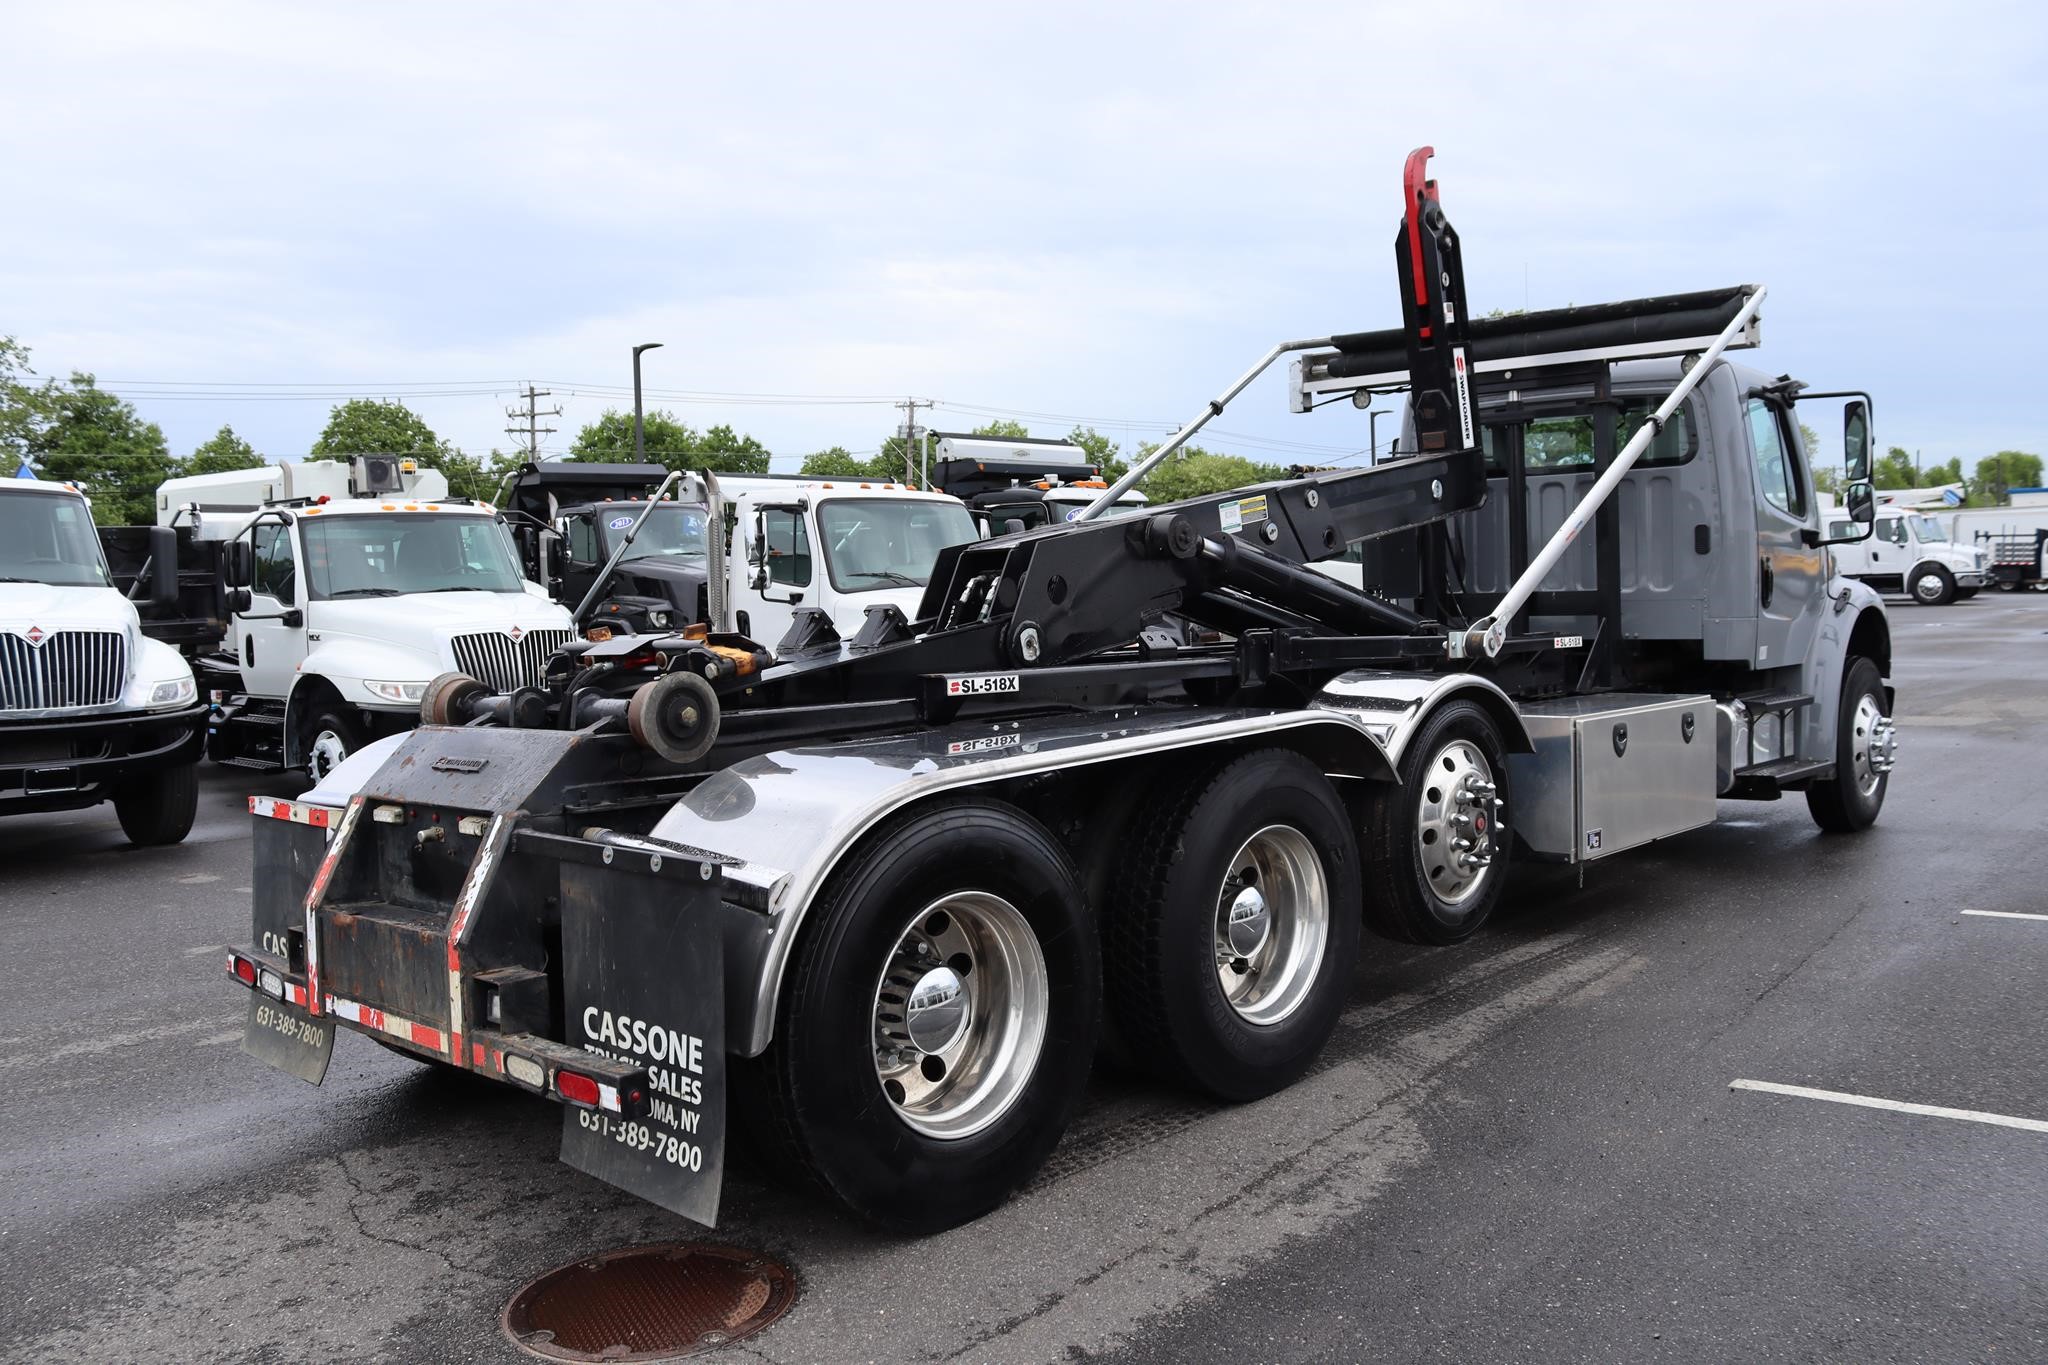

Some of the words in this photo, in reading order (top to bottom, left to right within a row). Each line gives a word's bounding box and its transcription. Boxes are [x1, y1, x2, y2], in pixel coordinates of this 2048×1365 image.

[1459, 375, 1470, 440] SWAPLOADER
[961, 677, 1016, 693] SL-518X
[256, 1005, 324, 1048] 631-389-7800
[583, 1006, 703, 1075] CASSONE
[648, 1065, 702, 1105] SALES
[579, 1109, 702, 1173] 631-389-7800
[681, 1108, 700, 1135] NY
